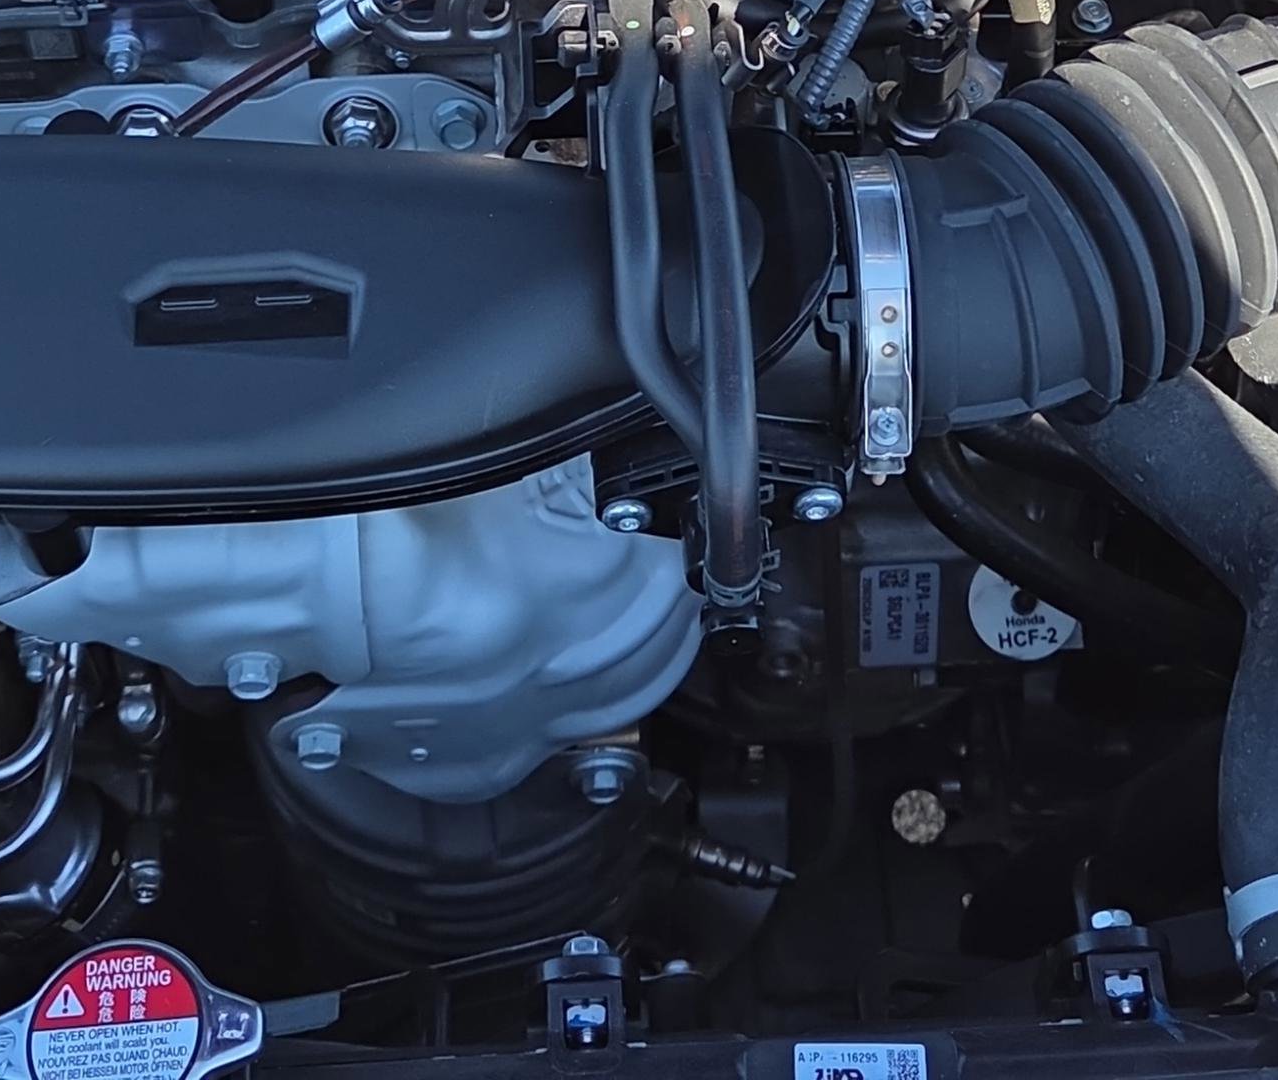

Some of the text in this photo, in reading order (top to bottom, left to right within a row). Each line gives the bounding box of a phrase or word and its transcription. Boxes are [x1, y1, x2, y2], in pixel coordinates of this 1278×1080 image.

[1005, 615, 1046, 628] Honda
[998, 627, 1058, 650] HCF-2
[85, 955, 156, 976] DANGER
[86, 969, 172, 992] WARNUNG
[49, 1021, 181, 1043] NEVER OPEN WHEN HOT.
[48, 1035, 170, 1055] Hot coolant will scald you.
[91, 1051, 112, 1064] PAS
[114, 1048, 150, 1063] QUAND
[152, 1045, 189, 1060] CHAUD.
[41, 1067, 65, 1080] NICHT
[67, 1066, 81, 1078] BEI
[82, 1065, 118, 1079] HEISSEM
[119, 1063, 150, 1076] MOTOR
